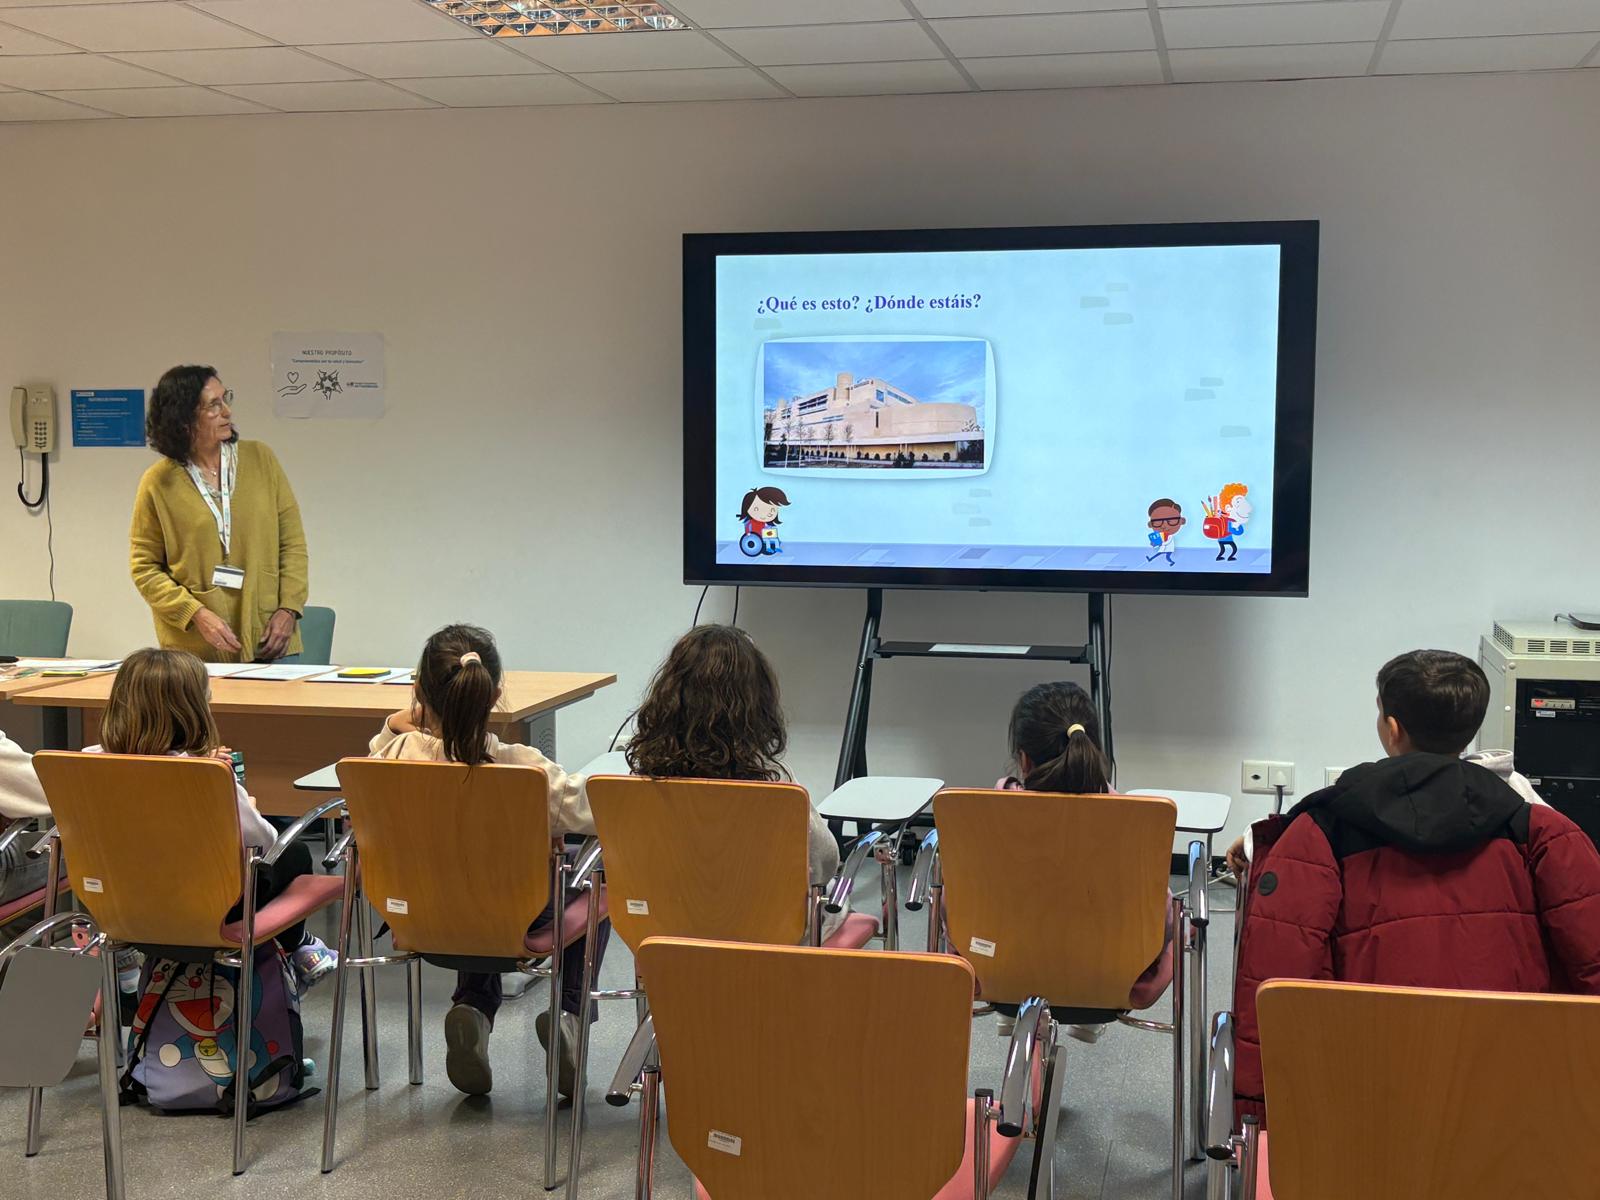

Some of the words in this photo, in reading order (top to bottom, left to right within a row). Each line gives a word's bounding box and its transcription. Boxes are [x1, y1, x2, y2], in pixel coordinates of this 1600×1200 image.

[756, 295, 798, 315] ¿Qué
[801, 299, 817, 311] es
[821, 295, 860, 311] esto?
[864, 294, 925, 314] ¿Dónde
[929, 293, 982, 310] estáis?
